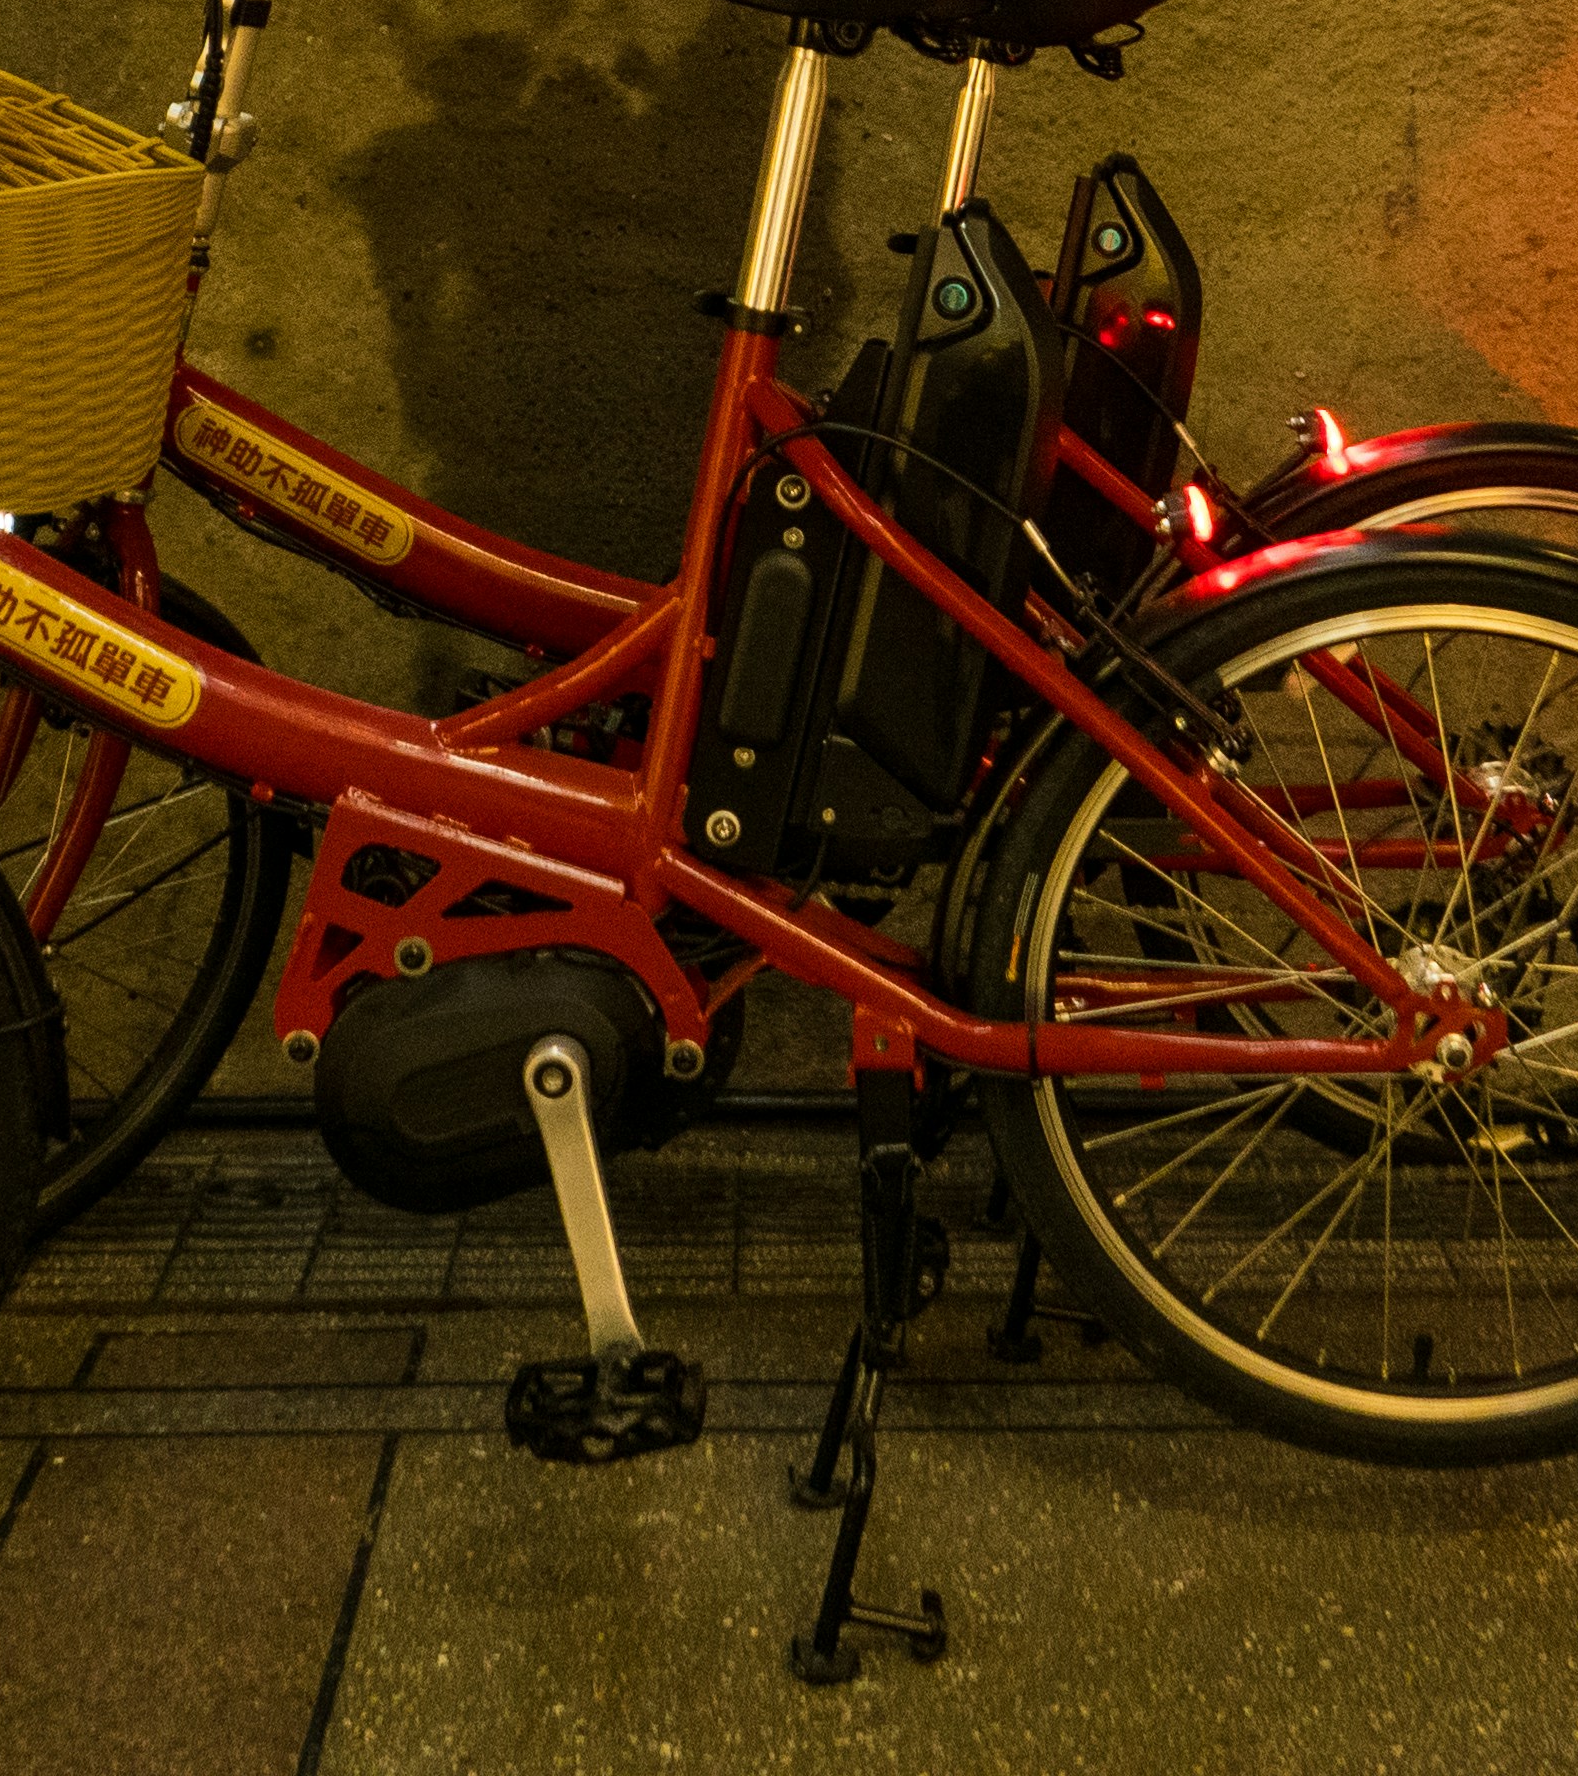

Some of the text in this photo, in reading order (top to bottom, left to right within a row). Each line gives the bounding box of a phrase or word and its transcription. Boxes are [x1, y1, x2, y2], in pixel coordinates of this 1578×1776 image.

[193, 418, 394, 549] 神助不孤單車
